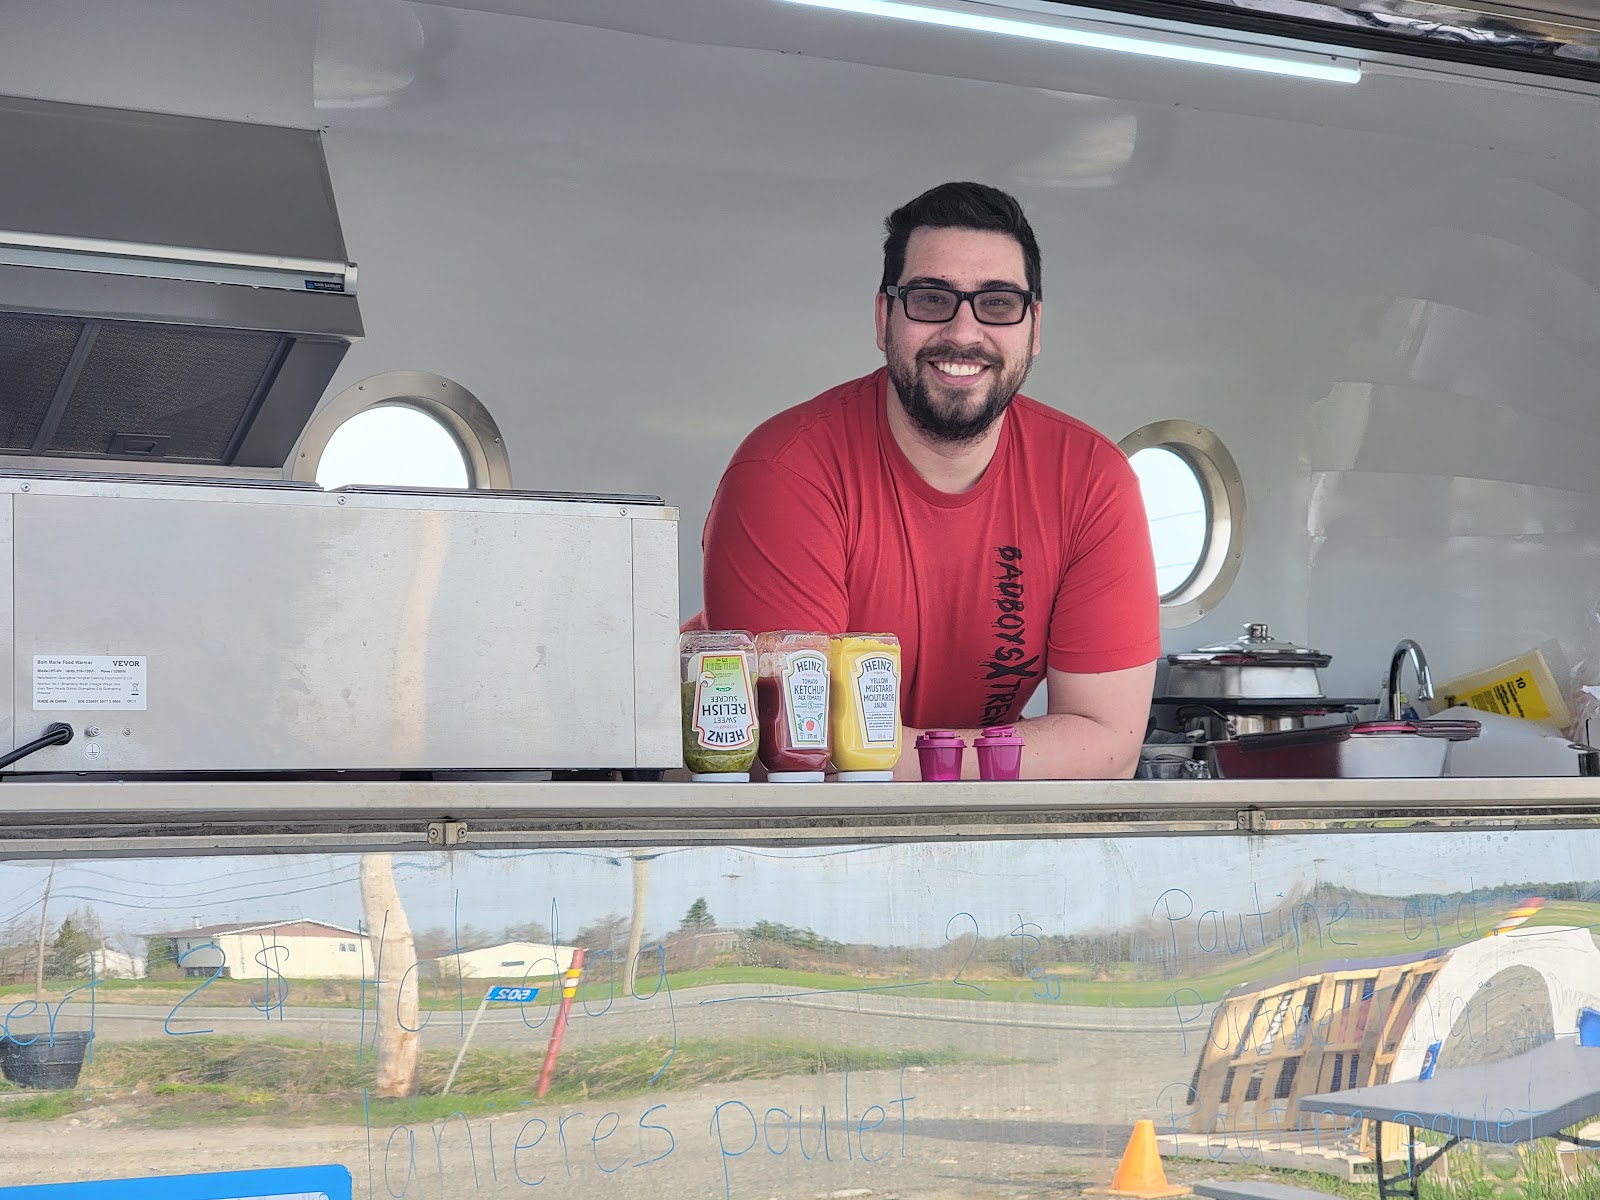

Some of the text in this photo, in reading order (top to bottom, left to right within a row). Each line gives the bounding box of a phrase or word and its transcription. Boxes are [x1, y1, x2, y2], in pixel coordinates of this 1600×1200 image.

[796, 660, 821, 673] HEINZ
[864, 660, 891, 672] HEINZ
[794, 685, 825, 695] KETCHUP
[865, 685, 893, 693] MUSTARD
[1515, 677, 1526, 689] 10
[863, 693, 895, 702] MOUTARDE
[702, 703, 747, 716] RELISH
[707, 728, 745, 743] HEINZ
[1152, 882, 1358, 960] Poutine
[521, 897, 676, 1084] dog
[0, 951, 104, 1065] ert
[1165, 986, 1336, 1056] Poutine
[710, 1067, 915, 1200] poulet
[1156, 1081, 1553, 1178] Poutine poulet
